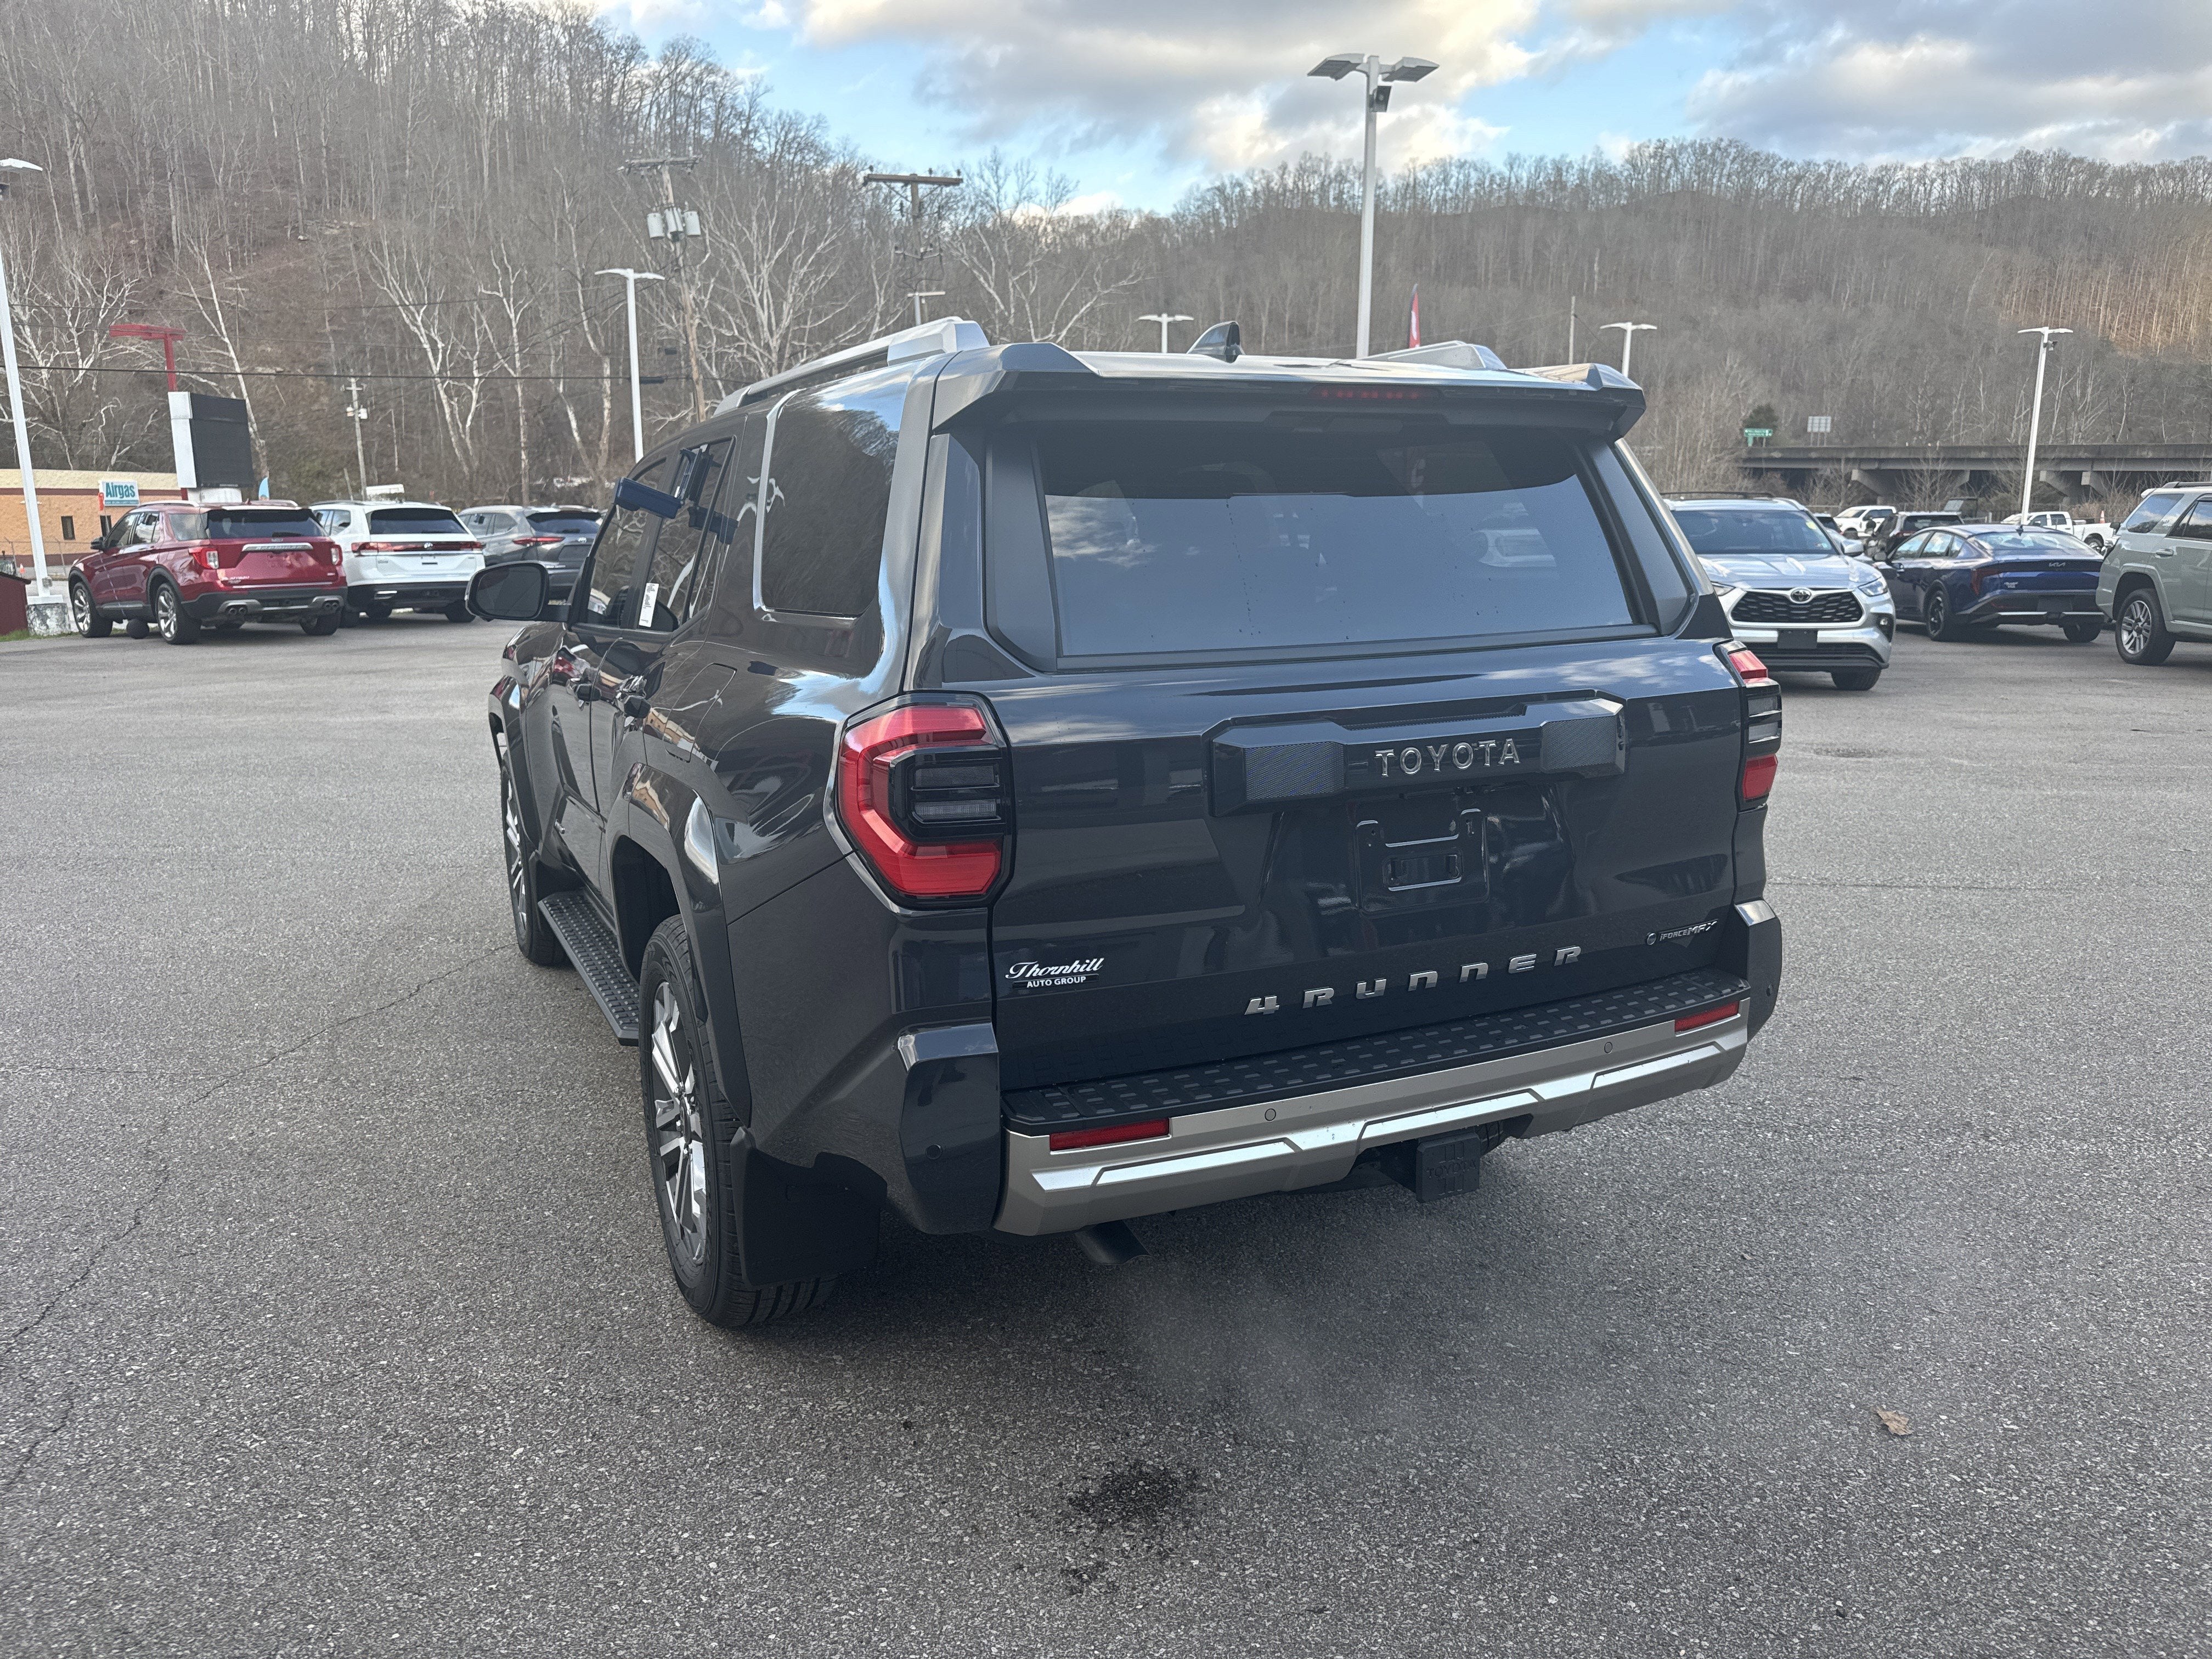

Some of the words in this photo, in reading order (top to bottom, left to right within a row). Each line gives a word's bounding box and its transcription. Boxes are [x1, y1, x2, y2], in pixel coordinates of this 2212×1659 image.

[106, 482, 136, 499] Airgas
[1374, 738, 1521, 777] TOYOTA
[1005, 957, 1105, 979] Thornhill
[1026, 979, 1052, 988] AUTO
[1054, 976, 1086, 985] GROUP
[1244, 945, 1582, 1015] 4RUNNER
[1426, 1159, 1476, 1180] TOYOTA
